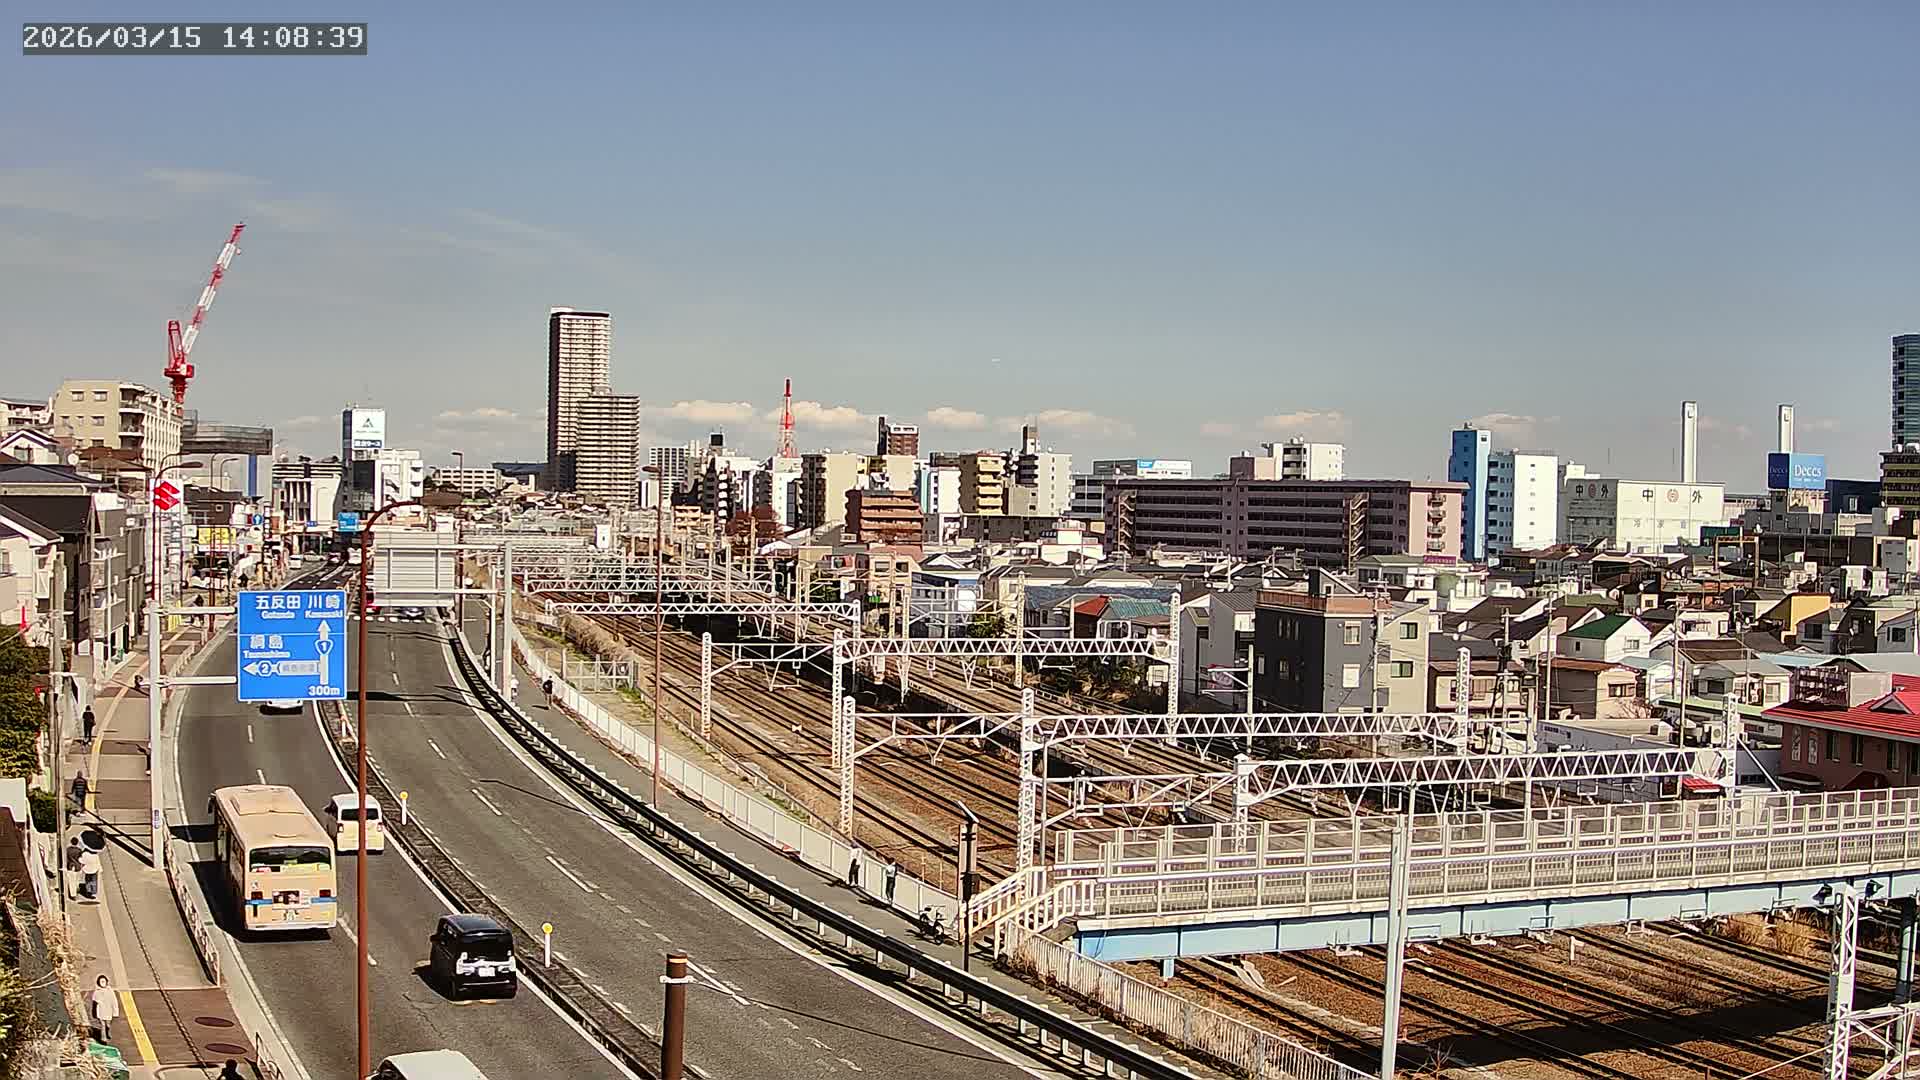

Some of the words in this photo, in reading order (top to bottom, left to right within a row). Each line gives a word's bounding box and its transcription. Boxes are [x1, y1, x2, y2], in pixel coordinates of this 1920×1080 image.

[1794, 464, 1822, 477] Deccs
[255, 595, 301, 610] 五反田
[307, 594, 340, 609] 川崎
[308, 685, 340, 696] 300m
